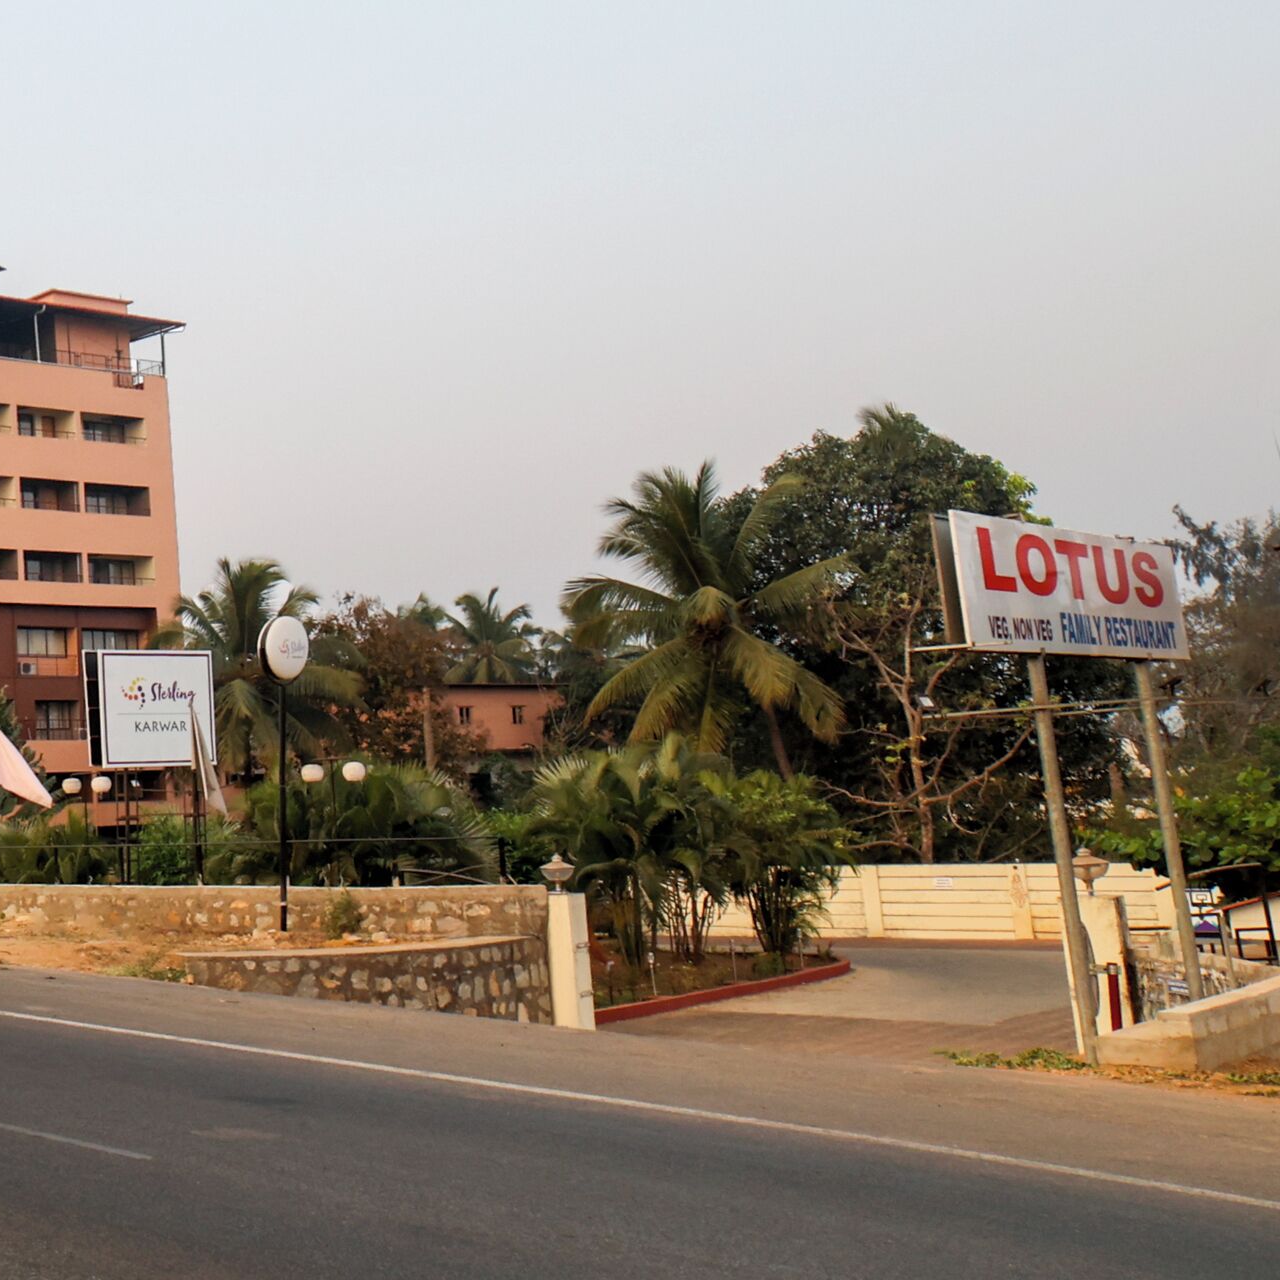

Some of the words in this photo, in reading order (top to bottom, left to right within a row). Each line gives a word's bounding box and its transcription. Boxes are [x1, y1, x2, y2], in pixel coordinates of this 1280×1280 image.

[976, 526, 1164, 608] LOTUS
[1013, 617, 1034, 640] NON
[1034, 619, 1054, 641] VEG
[1059, 612, 1103, 645] FAMILY
[1104, 617, 1177, 649] RESTAURANT
[151, 681, 196, 705] Sterling
[134, 720, 188, 733] KARWAR
